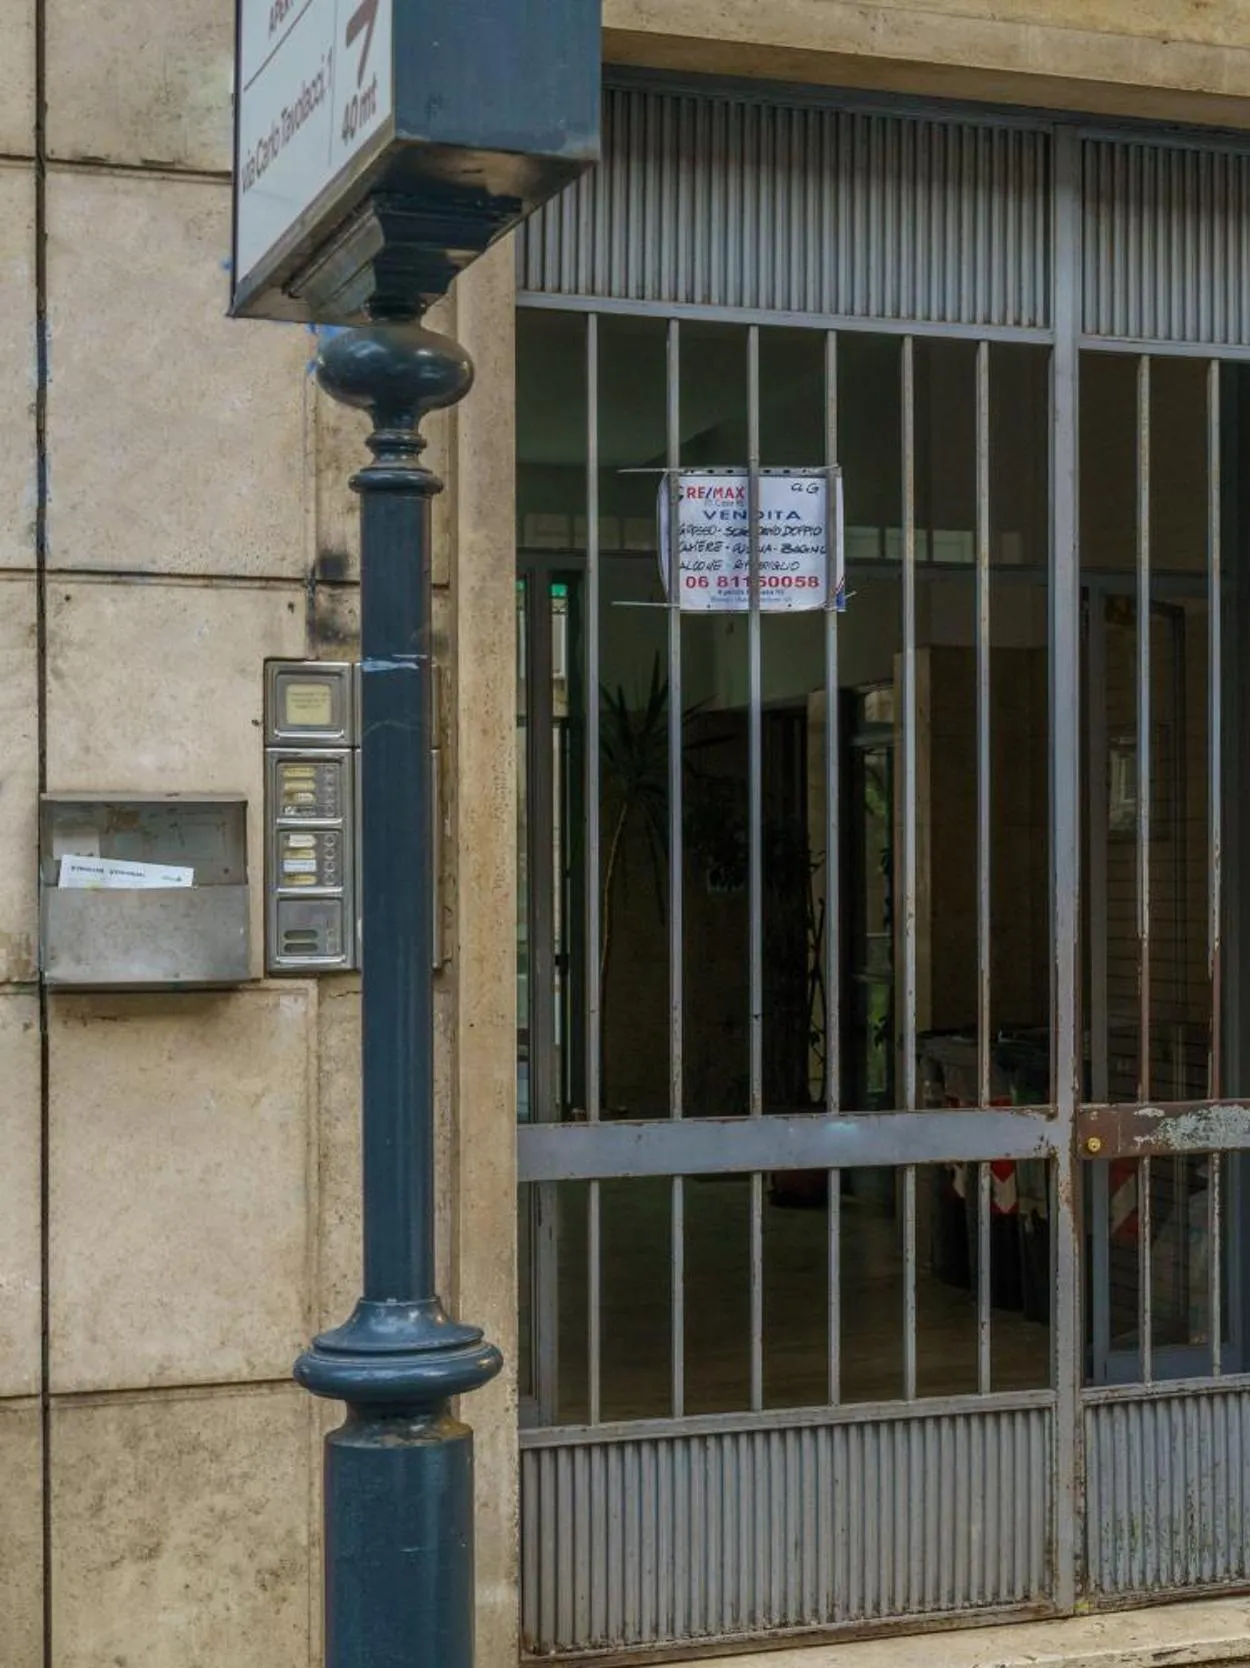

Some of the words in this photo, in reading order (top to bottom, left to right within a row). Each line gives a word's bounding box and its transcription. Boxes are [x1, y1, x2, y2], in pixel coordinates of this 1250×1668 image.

[341, 94, 359, 147] 40
[256, 120, 281, 178] Carlo
[686, 485, 745, 499] RE/MAX
[686, 575, 709, 588] 06
